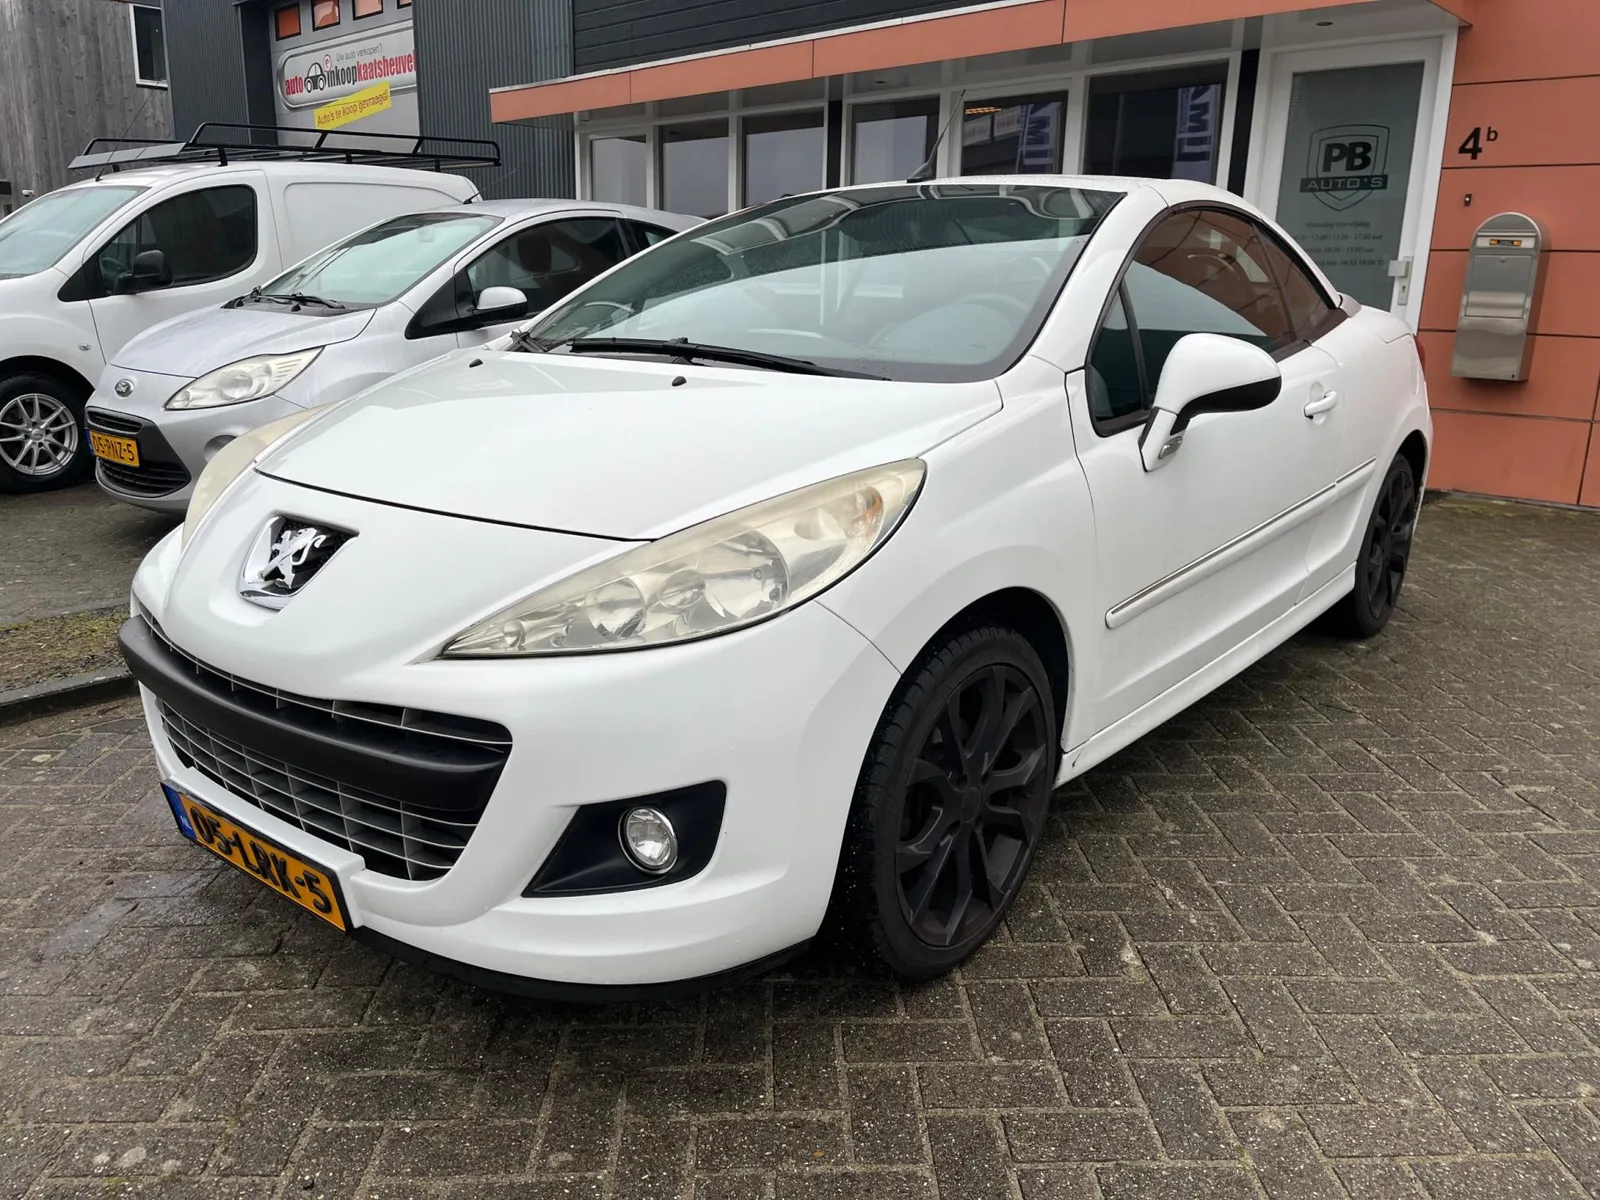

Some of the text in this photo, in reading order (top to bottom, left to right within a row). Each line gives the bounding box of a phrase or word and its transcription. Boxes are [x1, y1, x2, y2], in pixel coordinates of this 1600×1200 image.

[336, 43, 383, 61] Uw auto verkopen?
[285, 76, 304, 95] auto
[317, 110, 335, 126] Auto's
[335, 109, 342, 119] te
[342, 104, 358, 116] koop
[1322, 142, 1372, 172] PB
[1306, 177, 1383, 190] AUTO'S
[190, 806, 332, 913] 05-LRK-5
